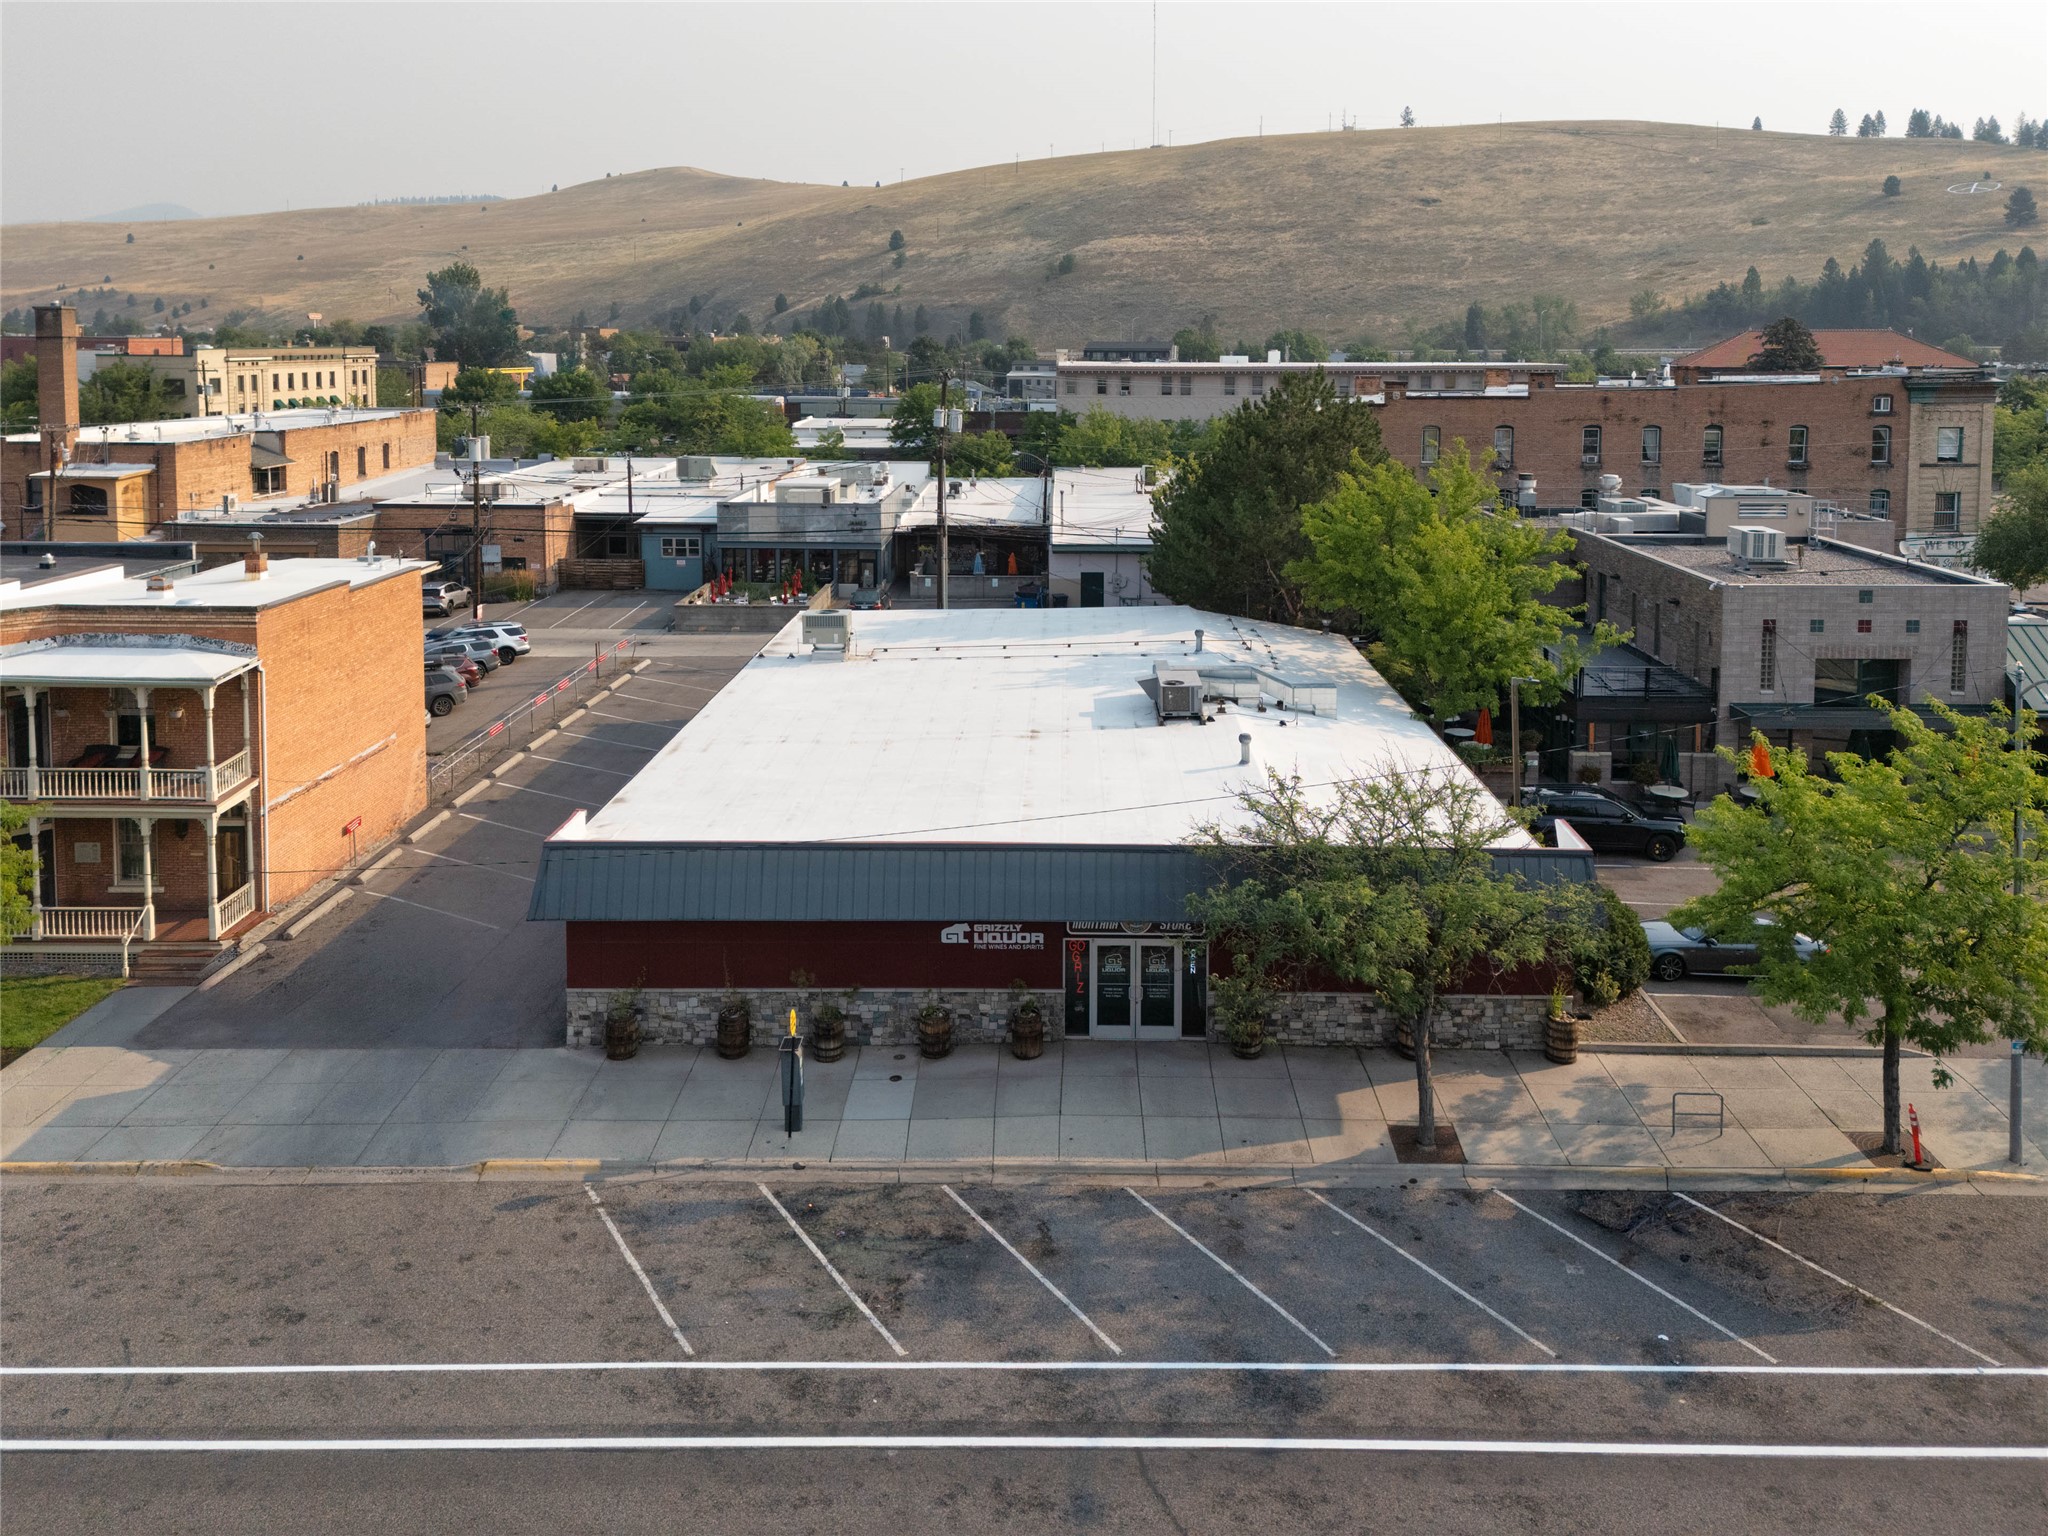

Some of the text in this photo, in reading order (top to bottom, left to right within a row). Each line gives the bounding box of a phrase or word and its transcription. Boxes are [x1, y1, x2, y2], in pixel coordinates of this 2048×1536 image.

[1925, 541, 1942, 550] WE
[973, 924, 1022, 932] GRIZZLY
[973, 932, 1044, 944] LIQUOR
[1069, 940, 1086, 951] GO
